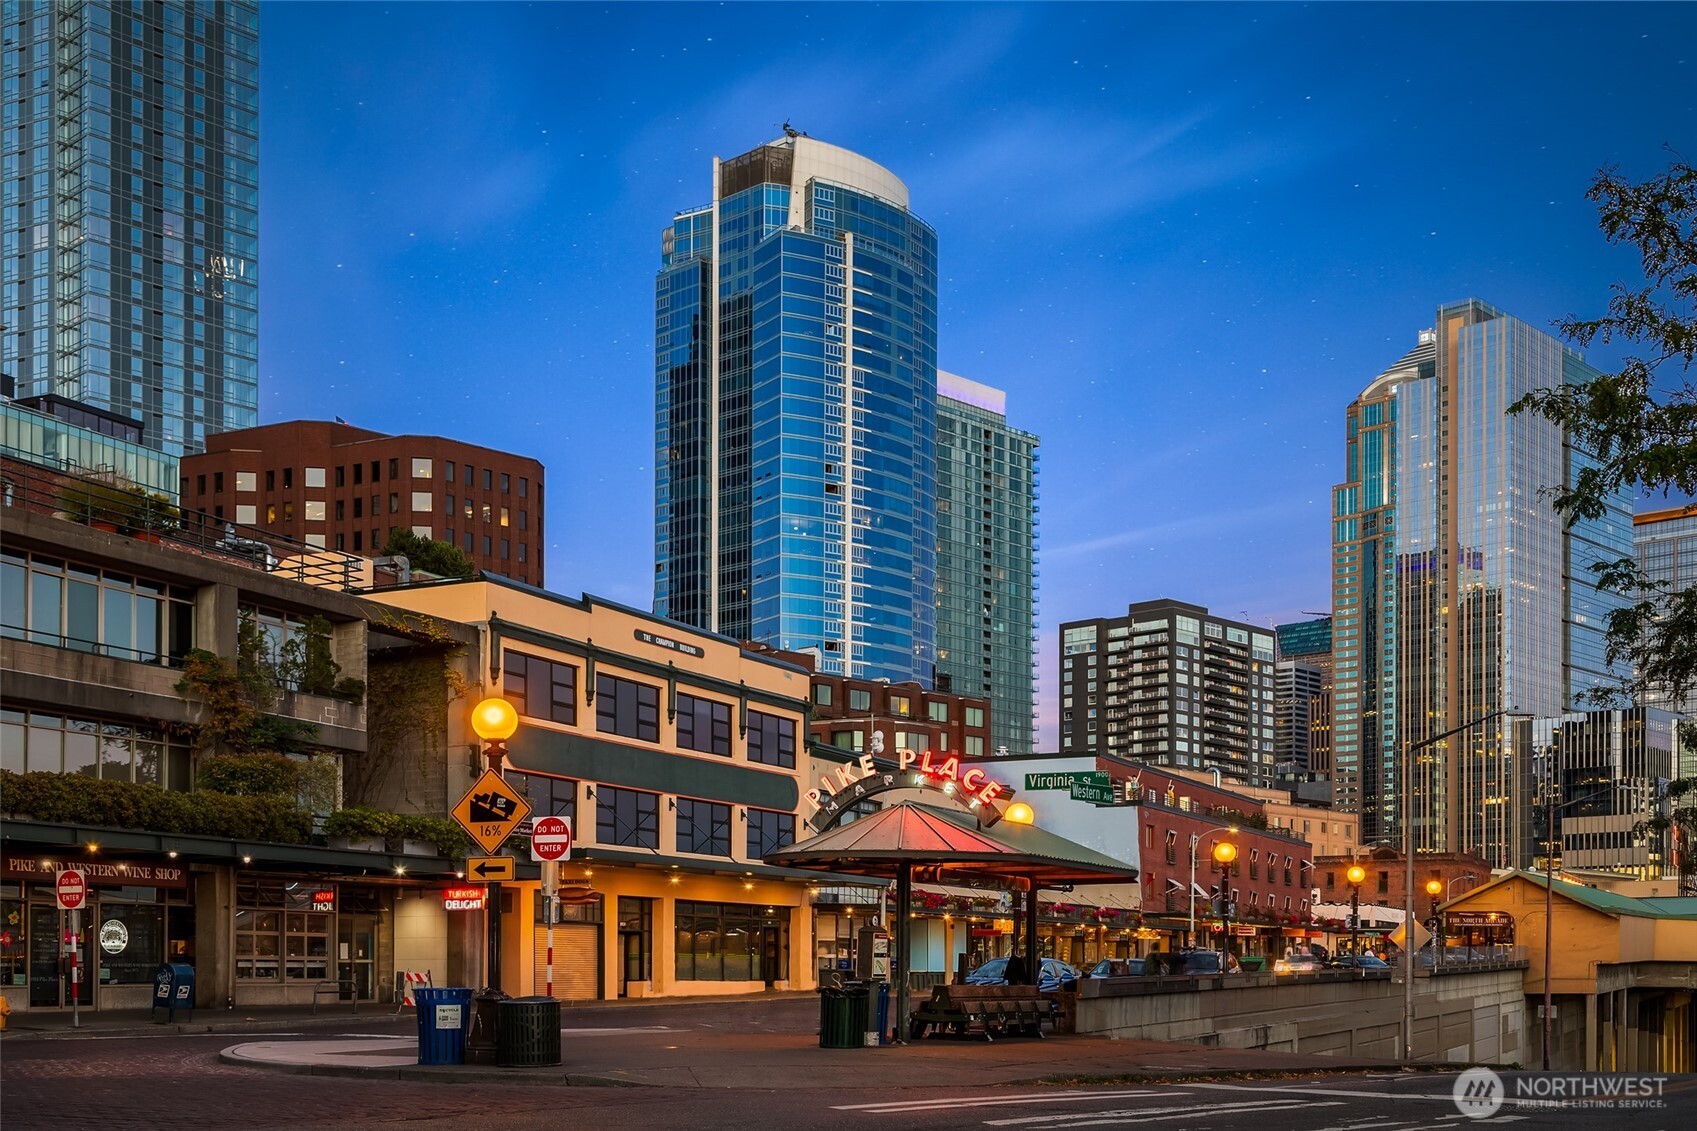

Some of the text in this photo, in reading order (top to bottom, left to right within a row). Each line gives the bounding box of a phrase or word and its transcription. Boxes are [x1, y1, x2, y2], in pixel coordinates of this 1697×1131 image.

[643, 633, 651, 642] THE
[655, 637, 675, 648] CHAMPION
[804, 749, 1002, 810] PIKE PLACE
[1028, 773, 1092, 790] Virginia St
[825, 773, 981, 815] MARKET
[1071, 783, 1113, 801] Western Ave
[480, 825, 502, 837] 16%
[9, 858, 181, 881] PIKE AND WESTERN WINE SHOP
[70, 877, 80, 885] NOT
[447, 889, 478, 898] TURKISH
[445, 899, 482, 910] DELIGHT
